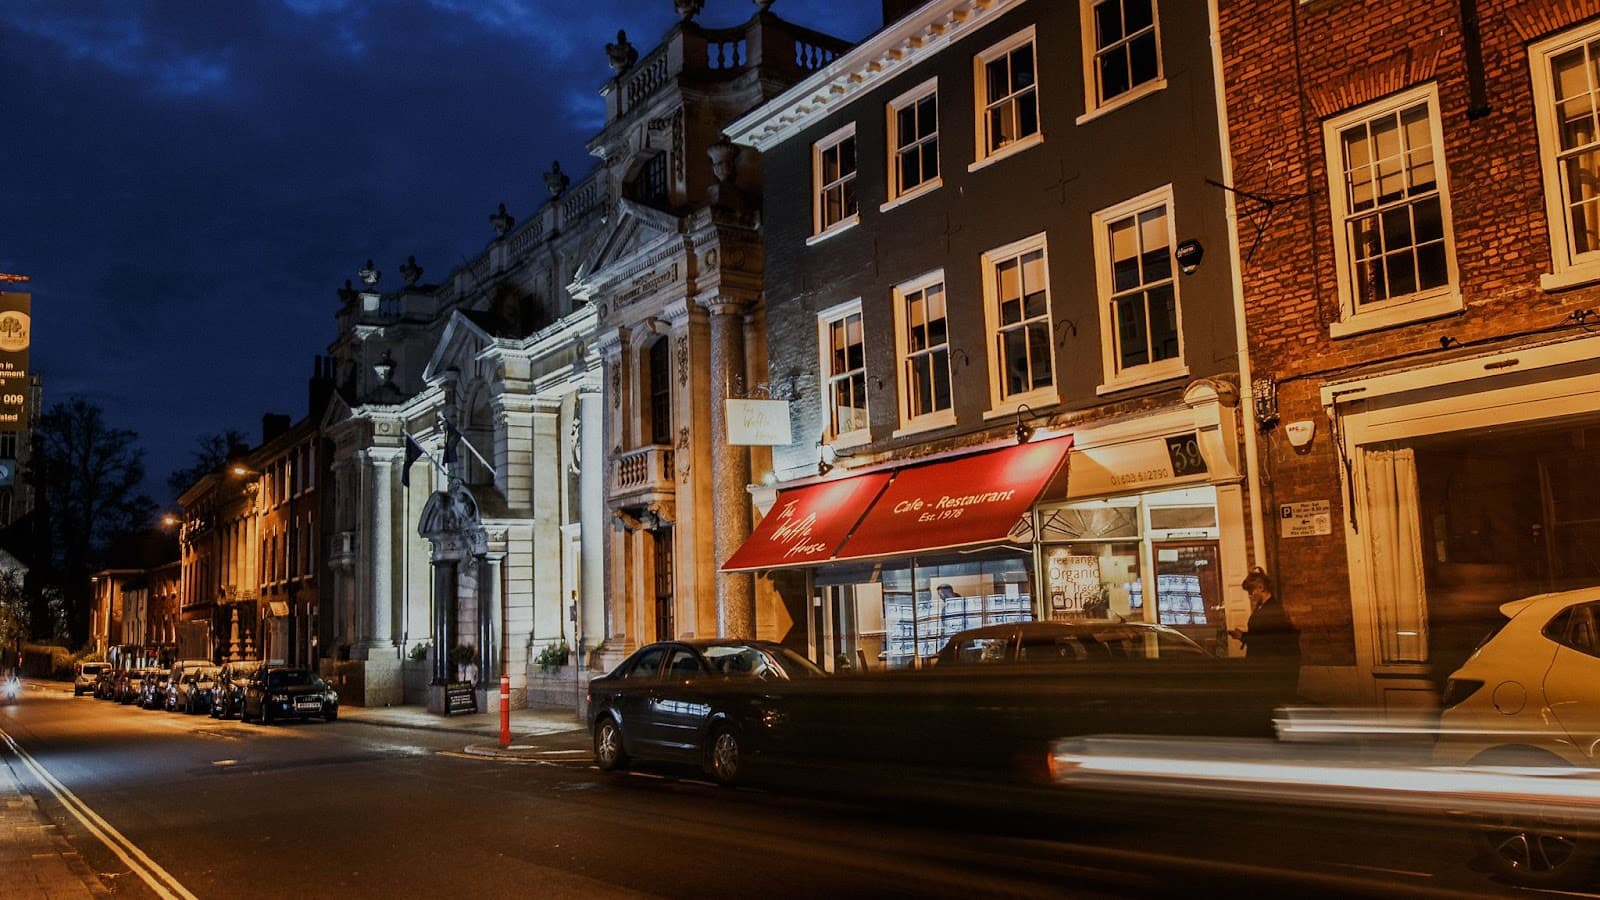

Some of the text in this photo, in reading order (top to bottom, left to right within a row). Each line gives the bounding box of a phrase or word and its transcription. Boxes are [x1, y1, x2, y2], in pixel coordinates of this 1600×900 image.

[1170, 439, 1202, 472] 39
[777, 499, 799, 520] The
[894, 498, 923, 514] Cafe
[936, 490, 1015, 509] Restaurant
[918, 508, 964, 522] Est. 1978
[770, 512, 816, 544] Waffle
[784, 537, 826, 558] House
[1050, 567, 1100, 583] Organic
